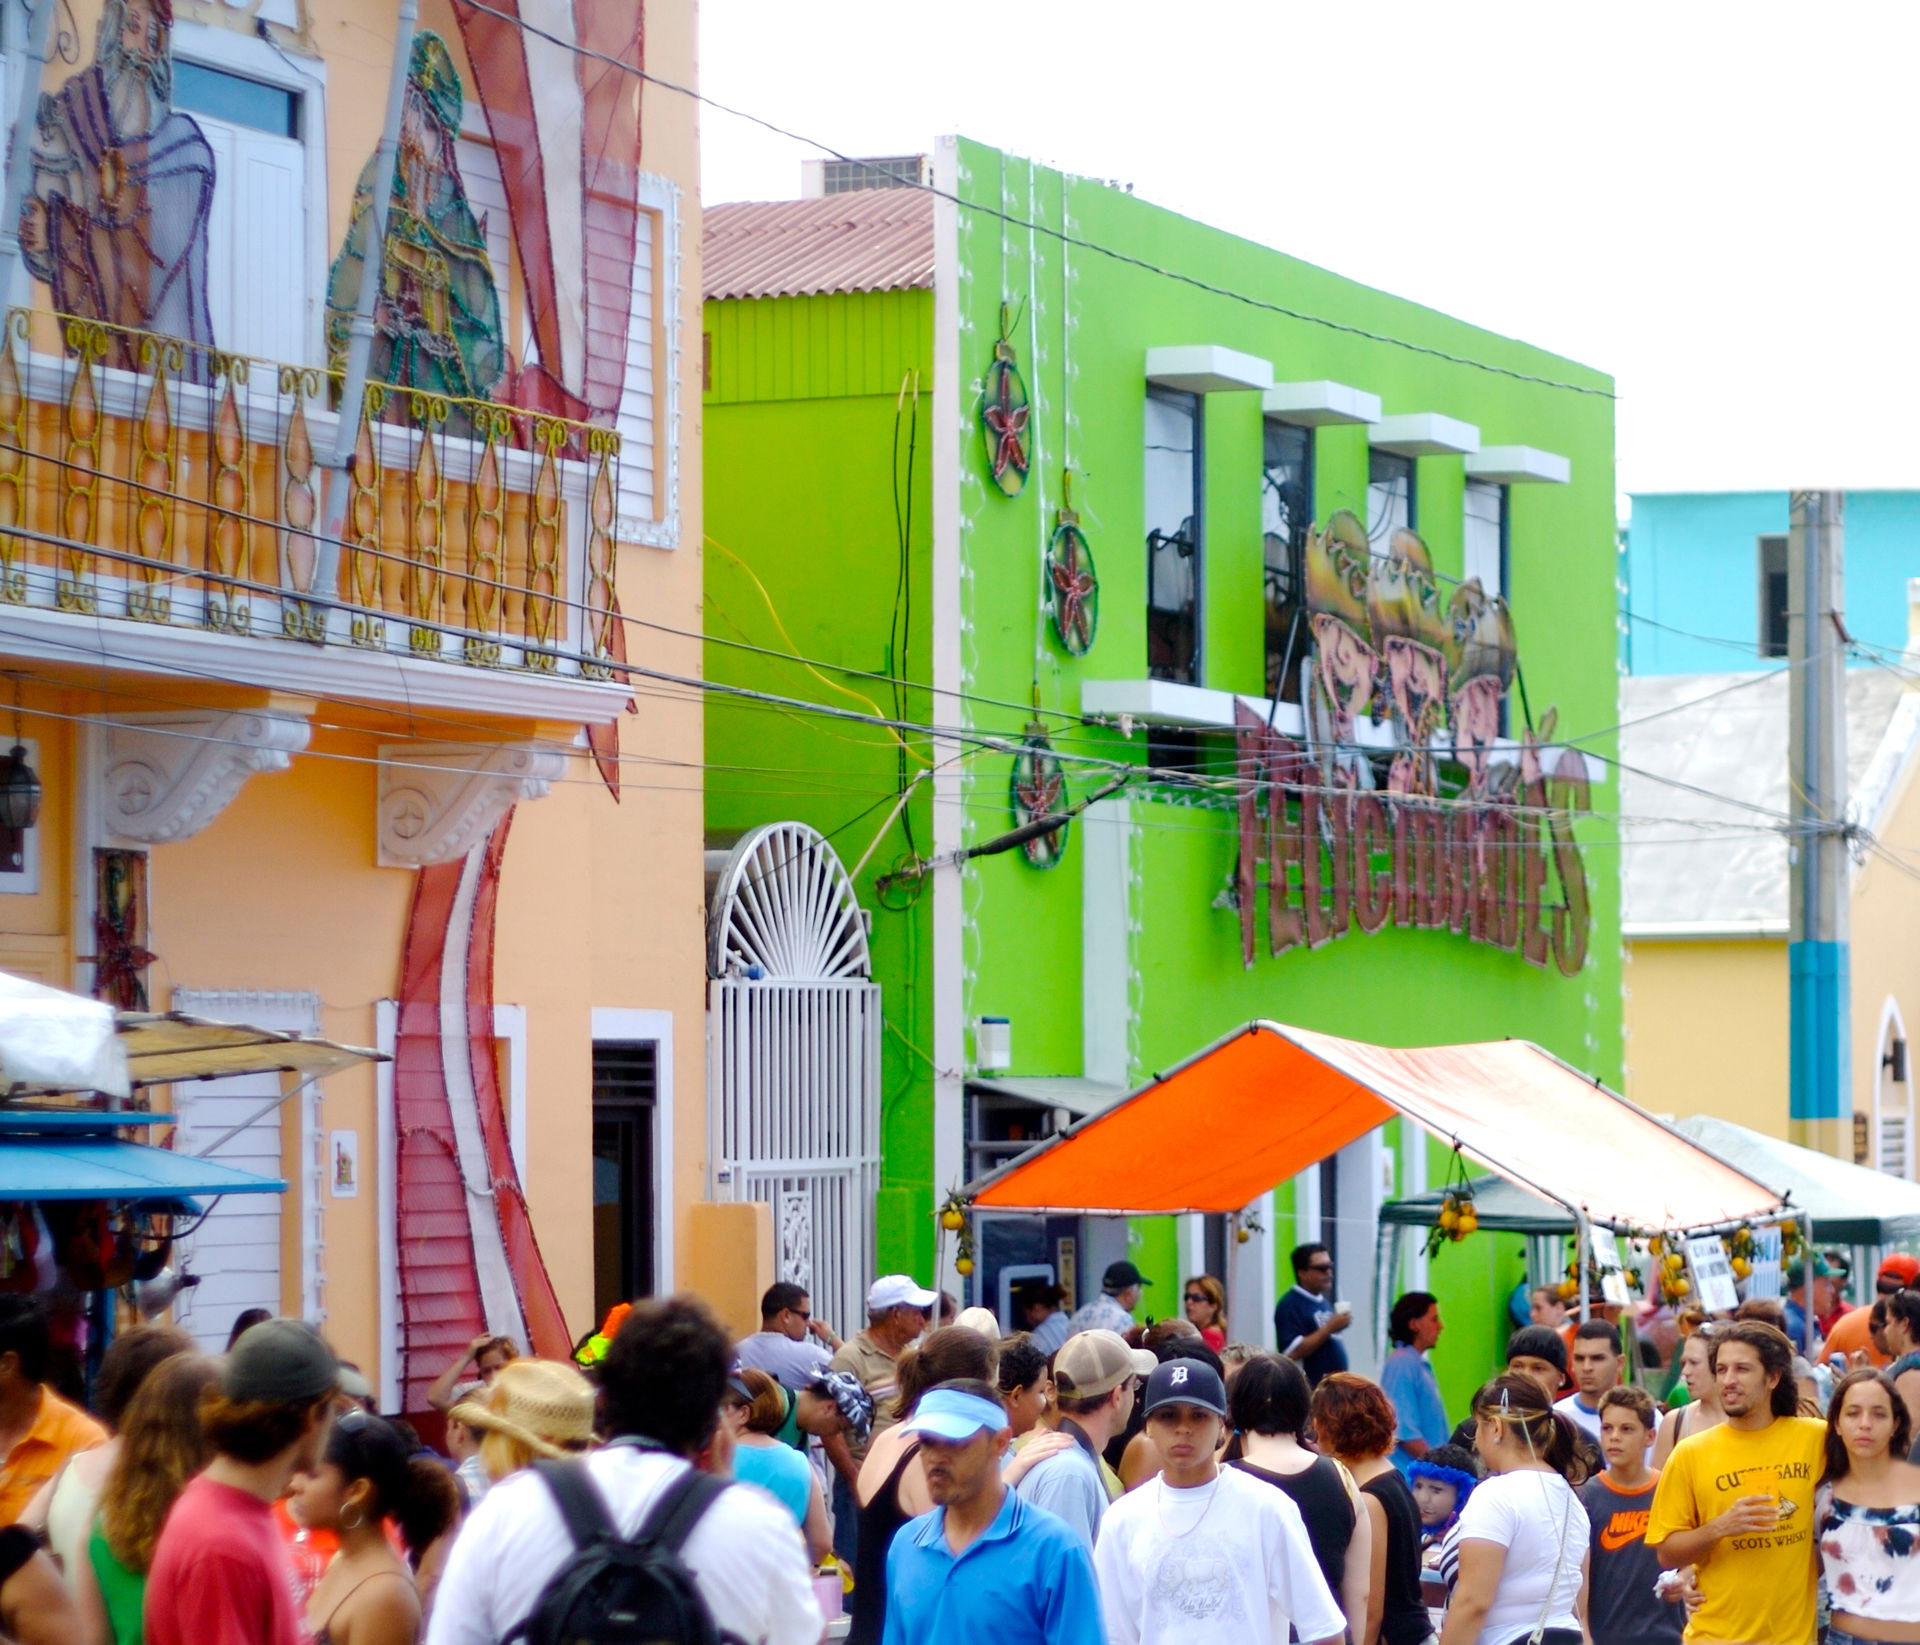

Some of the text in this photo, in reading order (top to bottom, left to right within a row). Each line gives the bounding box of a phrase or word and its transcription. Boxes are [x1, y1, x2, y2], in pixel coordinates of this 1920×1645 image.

[1170, 1366, 1188, 1386] D
[1609, 1511, 1650, 1533] NIKE
[1731, 1537, 1772, 1551] SCOTS
